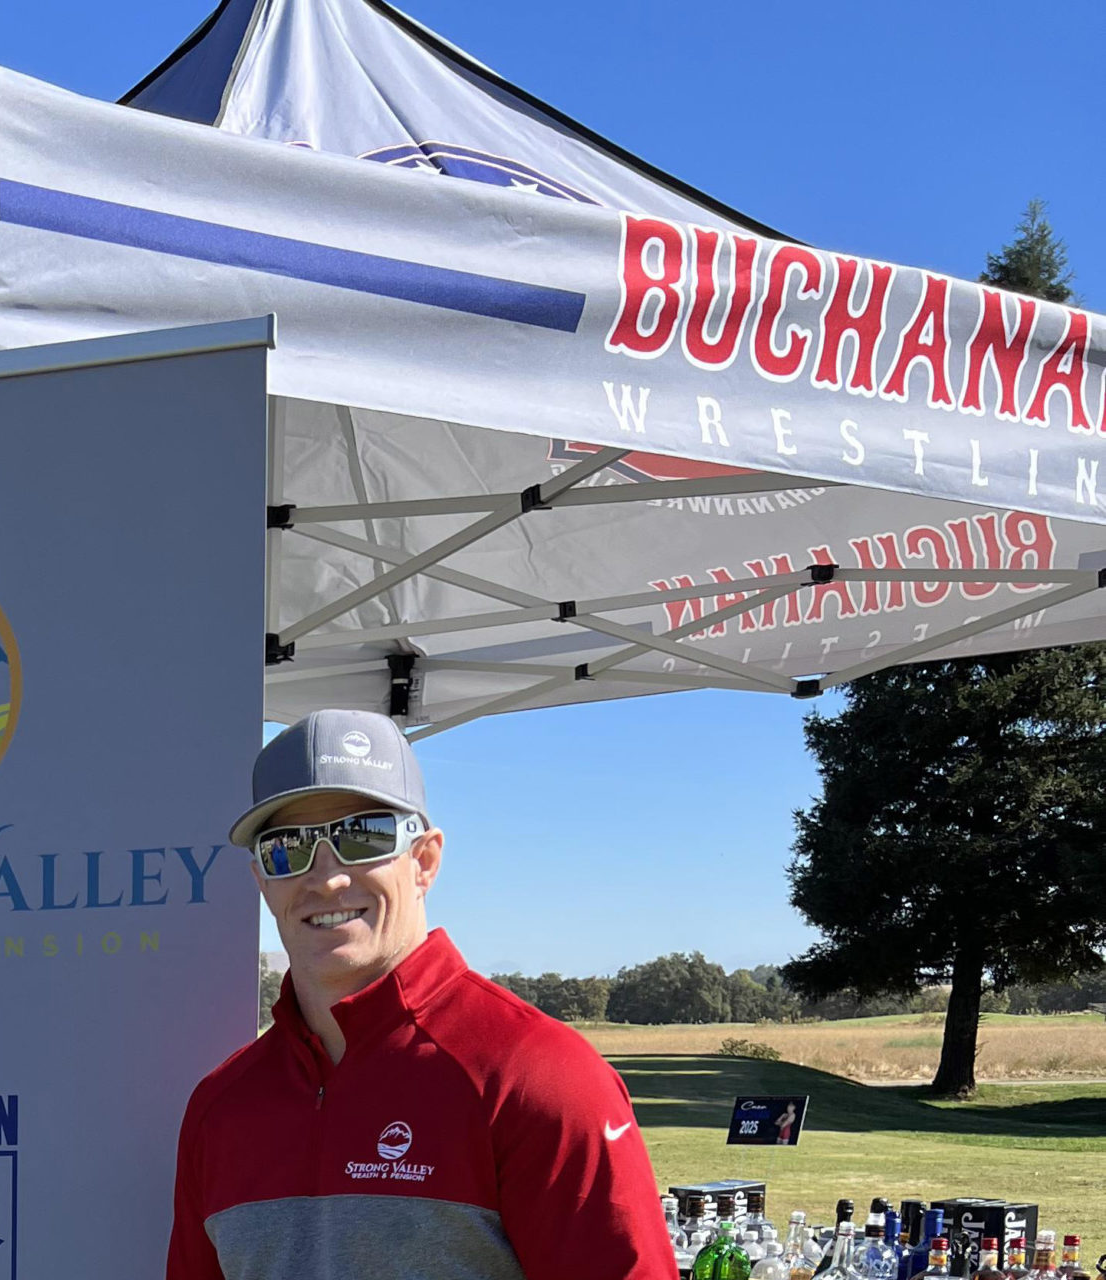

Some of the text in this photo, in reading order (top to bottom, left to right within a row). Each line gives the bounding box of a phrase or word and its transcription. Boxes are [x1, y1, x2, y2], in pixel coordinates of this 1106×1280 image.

[603, 211, 1106, 438] BUCHANA
[319, 755, 394, 771] STRONG VALLEY
[739, 1120, 760, 1135] 2025
[345, 1159, 435, 1176] STRONG VALLEY
[390, 1172, 425, 1182] PENSION
